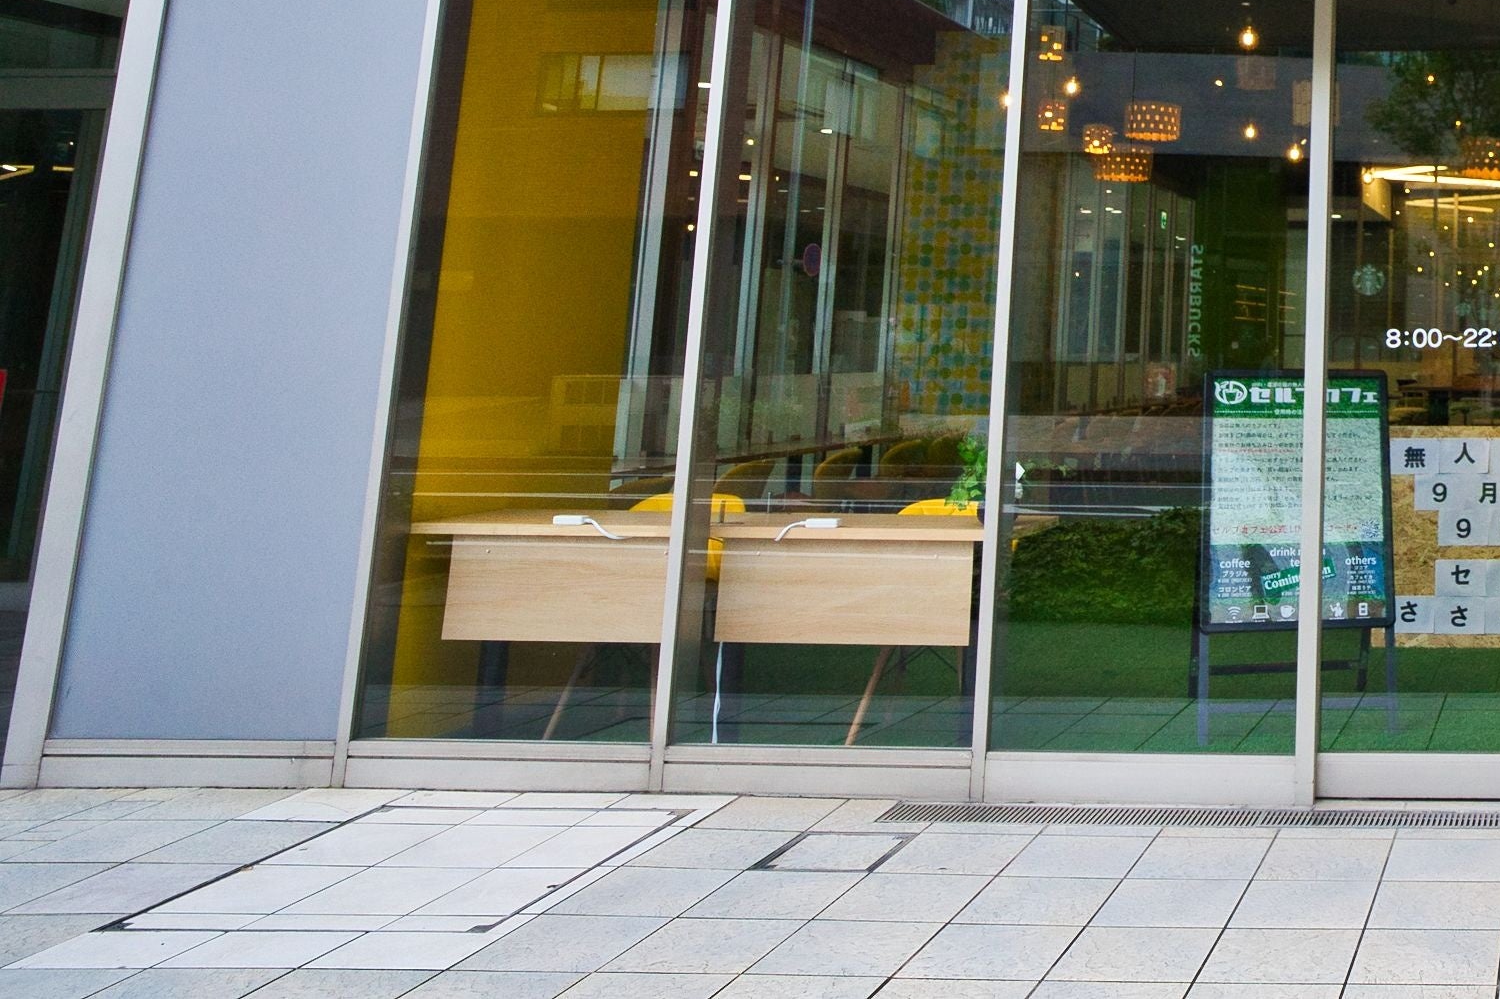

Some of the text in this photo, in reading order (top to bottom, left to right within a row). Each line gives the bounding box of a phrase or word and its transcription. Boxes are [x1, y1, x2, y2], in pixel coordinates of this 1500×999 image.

[1269, 547, 1296, 557] drink
[1219, 558, 1251, 569] coffee
[1291, 558, 1301, 568] te
[1344, 556, 1377, 565] others
[1264, 574, 1301, 590] Comin
